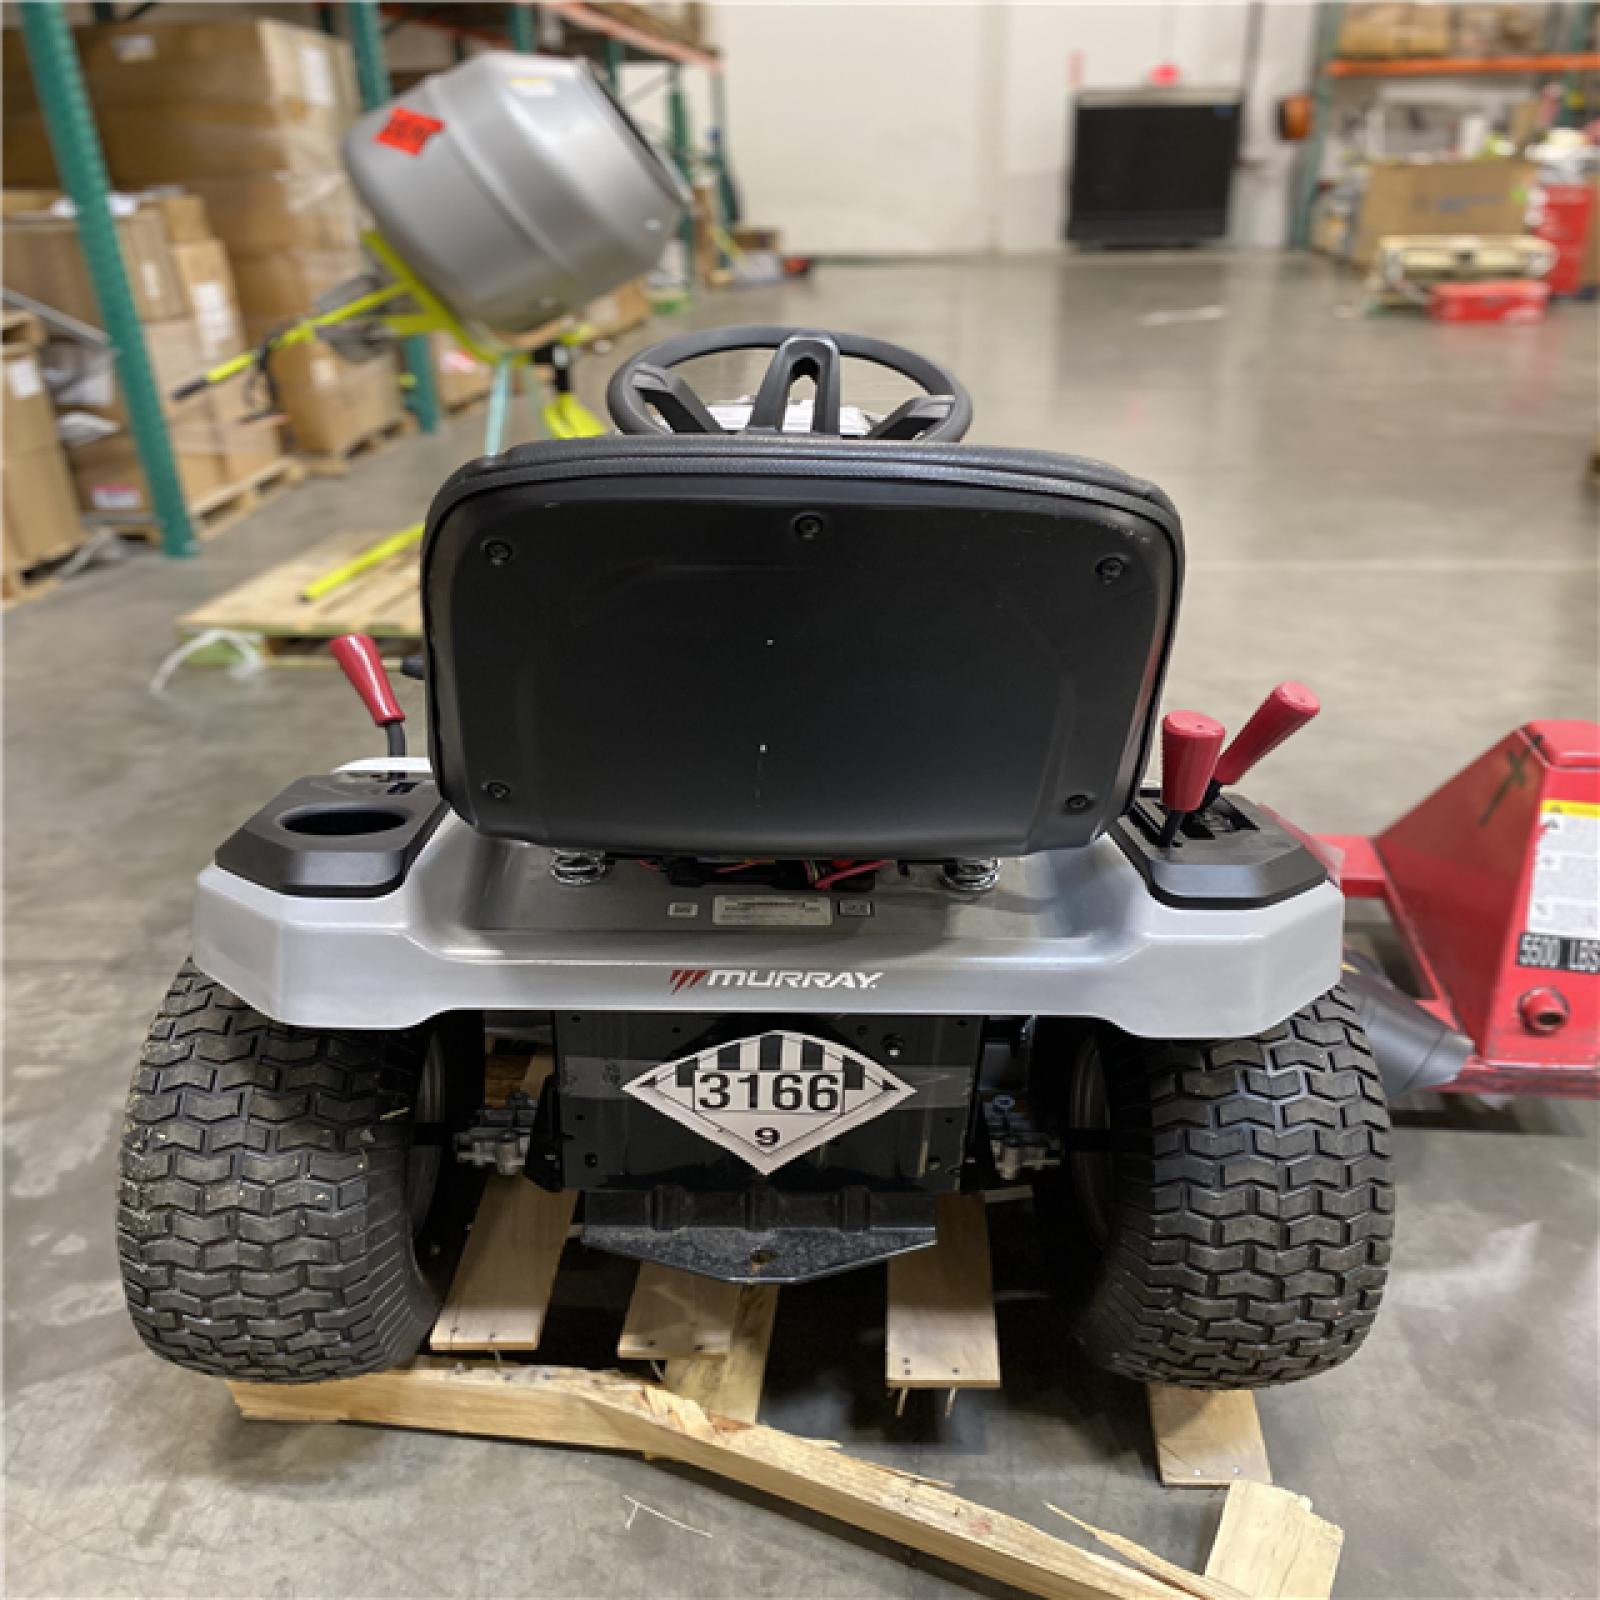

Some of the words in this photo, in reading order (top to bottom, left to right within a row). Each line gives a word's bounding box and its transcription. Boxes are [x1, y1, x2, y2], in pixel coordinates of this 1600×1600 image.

[1520, 933, 1558, 967] 5500
[699, 1074, 839, 1111] 3166
[754, 1127, 781, 1146] 9
